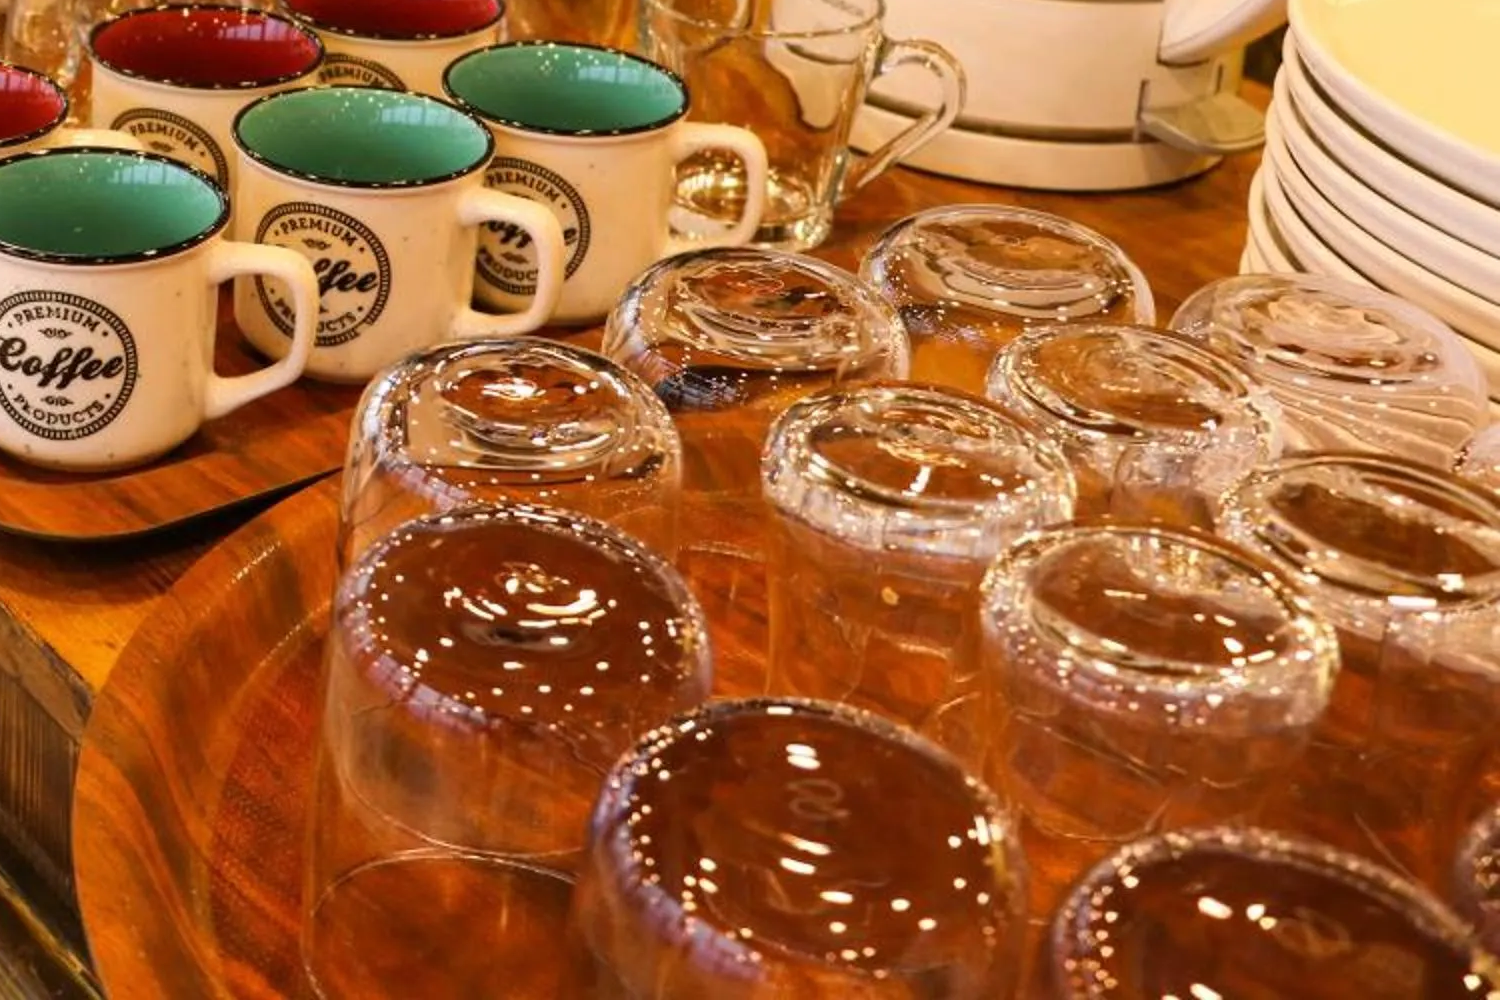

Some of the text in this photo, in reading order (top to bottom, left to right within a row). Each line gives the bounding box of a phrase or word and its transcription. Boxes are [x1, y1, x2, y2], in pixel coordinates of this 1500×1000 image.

[128, 121, 199, 151] PREMIUM
[485, 171, 561, 203] PREMIUM
[280, 216, 359, 248] PREMIUM
[13, 304, 101, 333] PREMIUM
[12, 393, 105, 426] PRODUCTS
